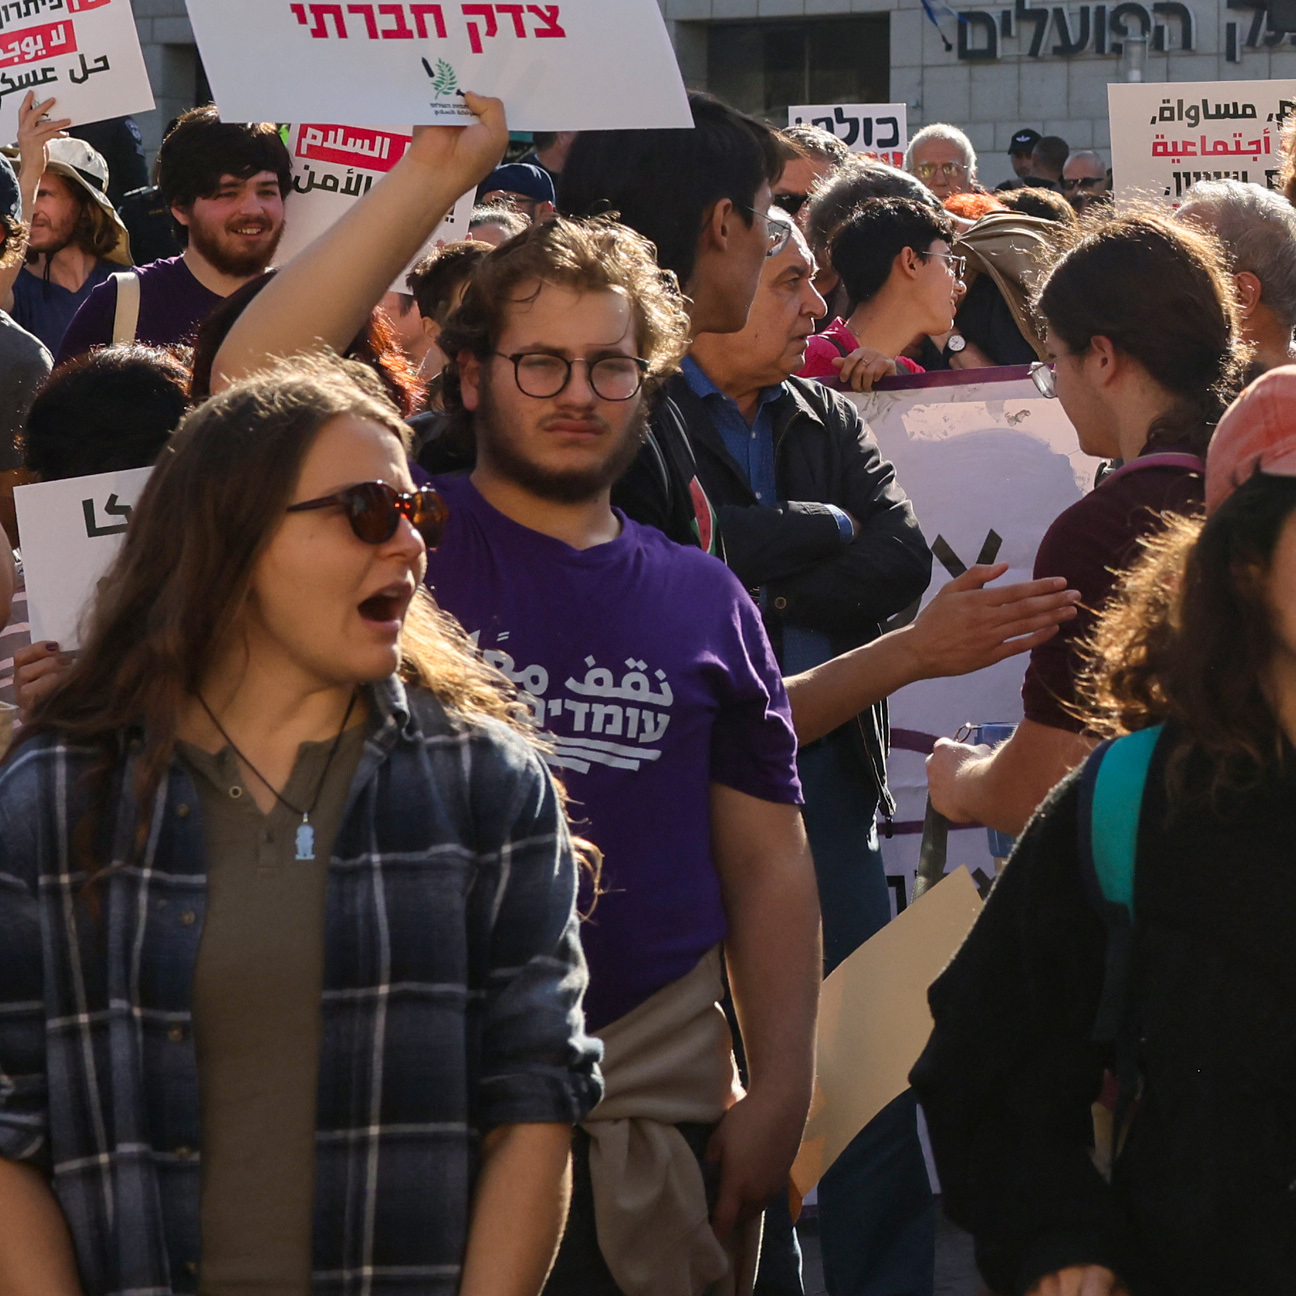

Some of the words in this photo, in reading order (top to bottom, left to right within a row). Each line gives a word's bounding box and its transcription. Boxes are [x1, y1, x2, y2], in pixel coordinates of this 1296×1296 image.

[49, 23, 68, 48] لا
[289, 3, 448, 40] חברתי
[462, 3, 567, 54] צדק
[68, 53, 111, 85] حل
[300, 126, 392, 160] السلام
[1151, 127, 1272, 165] أجتماعية
[293, 164, 374, 198] الأمن
[564, 654, 675, 708] نقف
